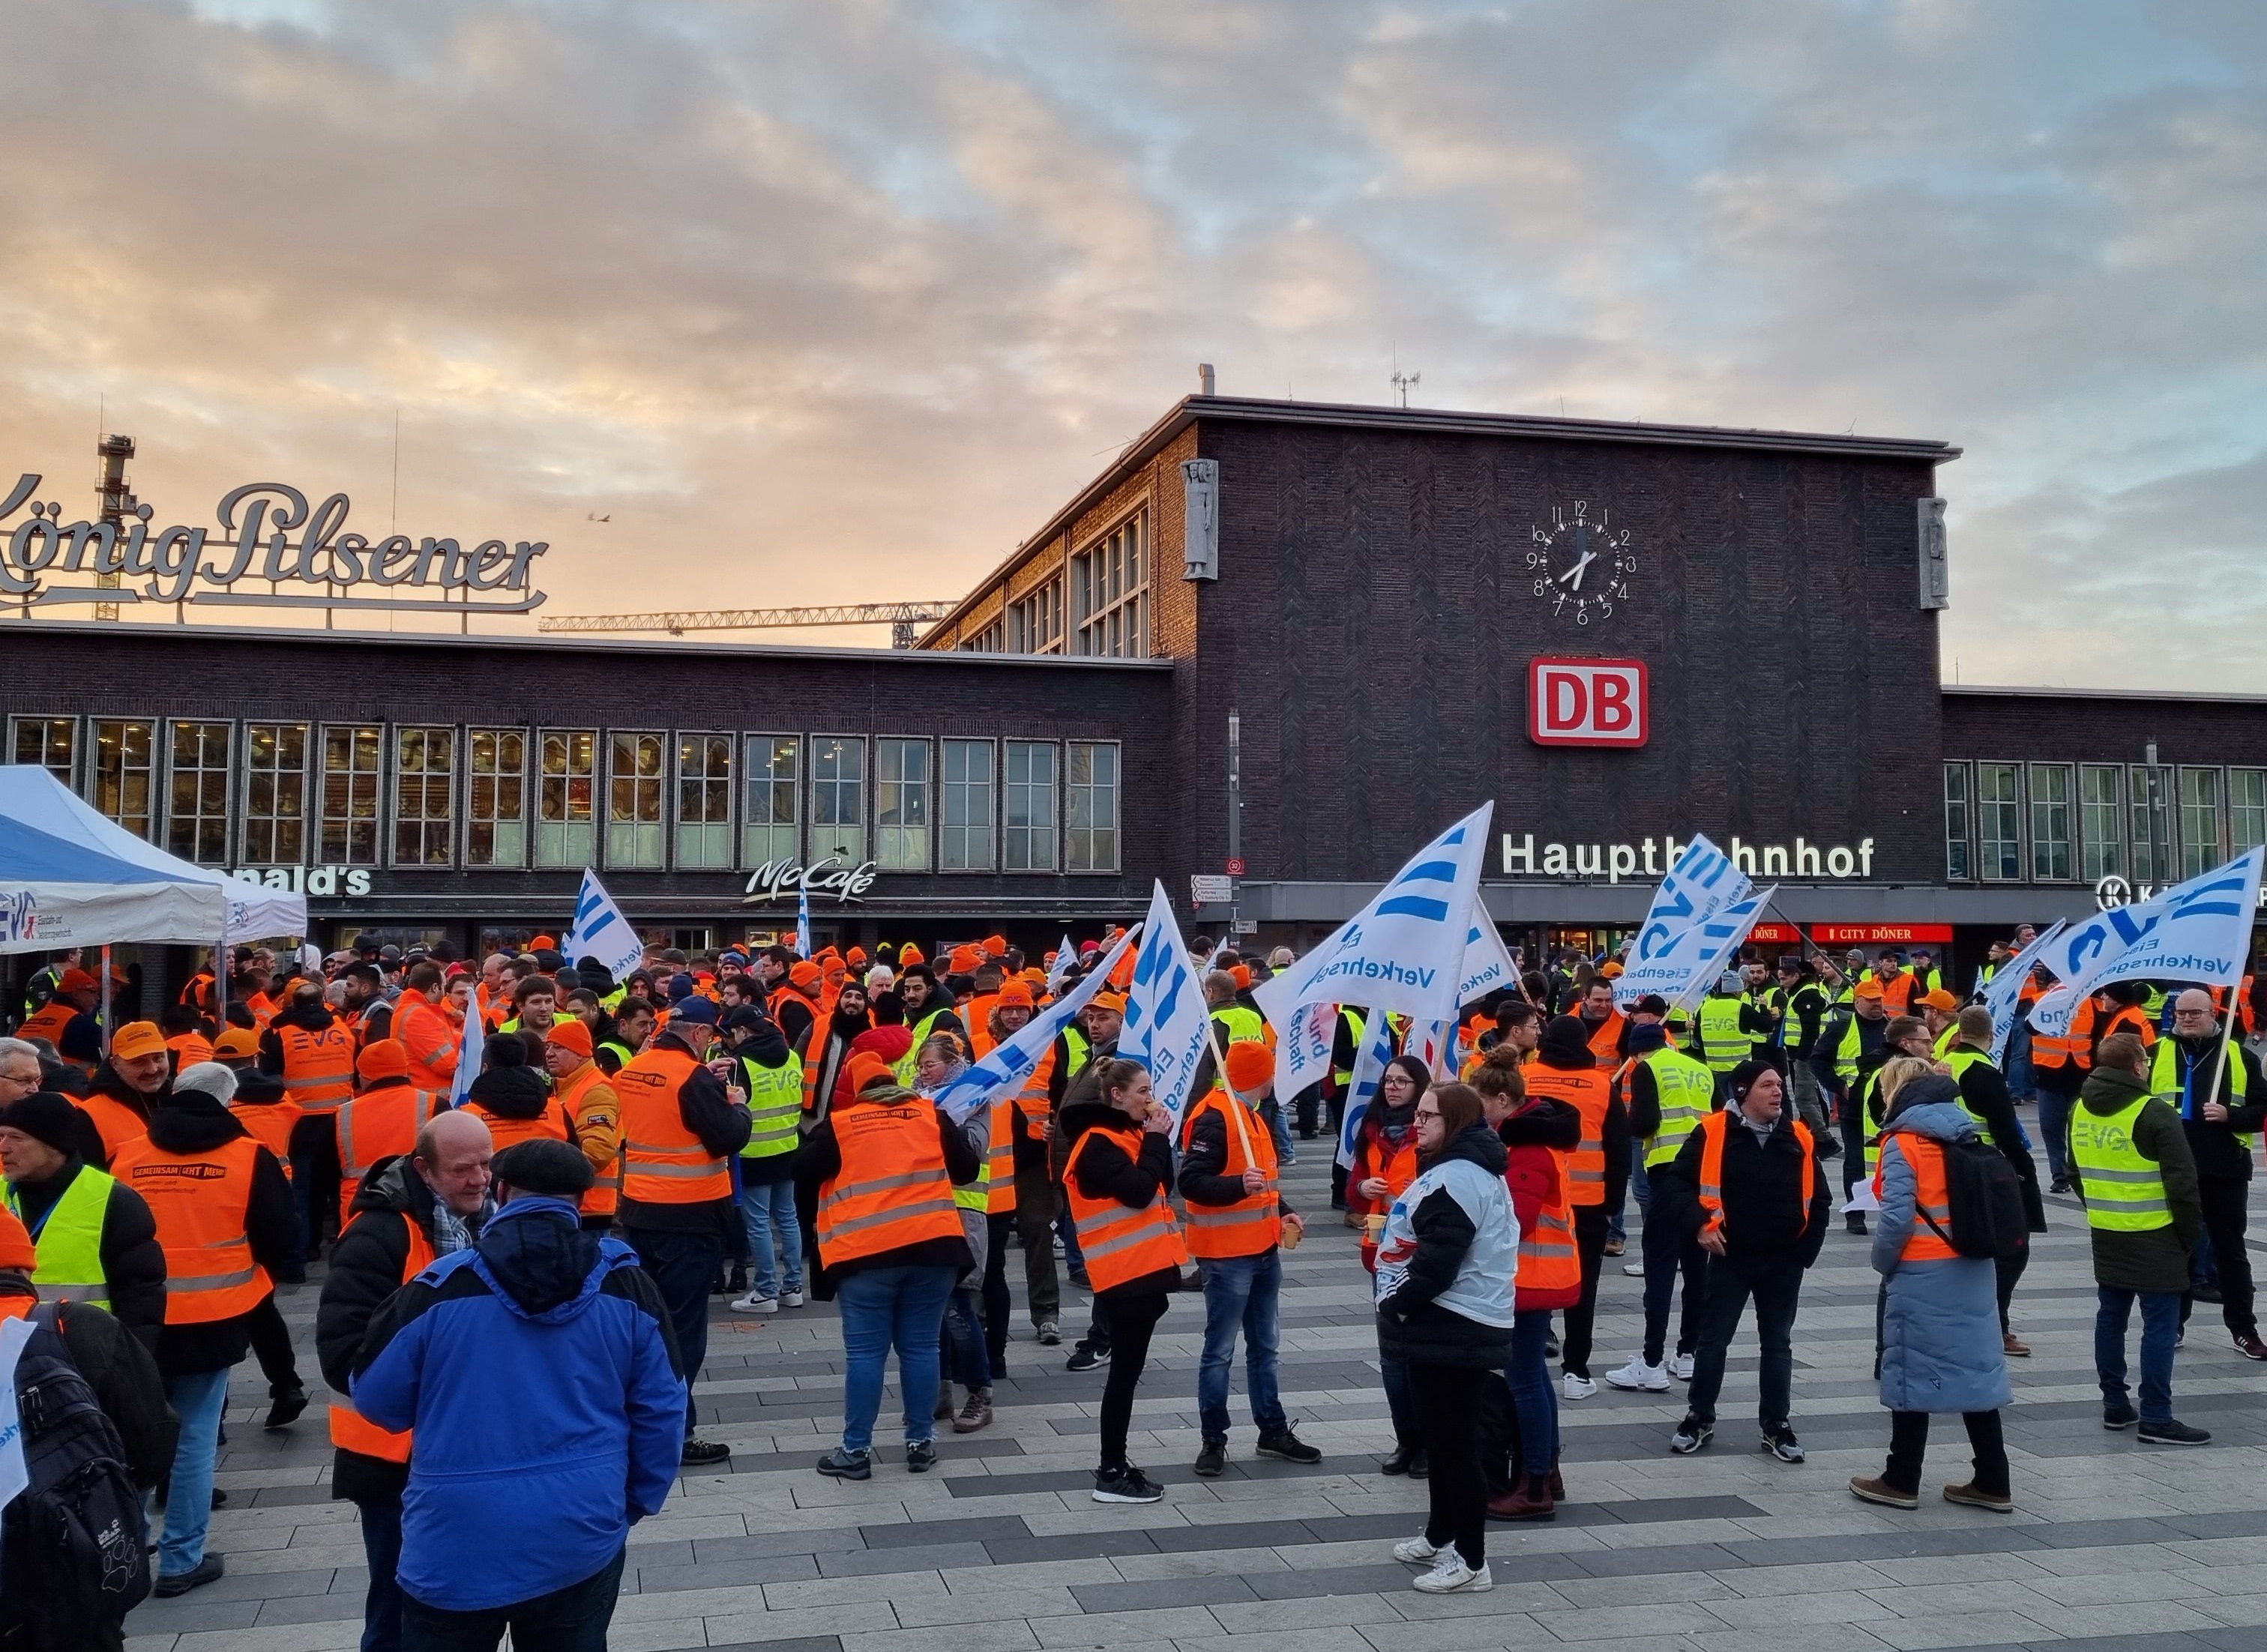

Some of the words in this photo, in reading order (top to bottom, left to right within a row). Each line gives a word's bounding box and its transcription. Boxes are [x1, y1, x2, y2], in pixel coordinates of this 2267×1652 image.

[1552, 507, 1562, 523] 11
[1575, 501, 1587, 518] 12
[202, 483, 549, 591] Pilsener
[1532, 525, 1546, 542] 10
[1621, 529, 1631, 546] 2
[1526, 553, 1538, 570] 9
[1626, 557, 1637, 572] 3
[1534, 579, 1544, 597] 8
[1618, 583, 1629, 600] 4
[1553, 601, 1562, 617] 7
[1577, 609, 1589, 625] 6
[1603, 603, 1612, 619] 5
[1546, 672, 1633, 732] DB
[1502, 833, 1874, 884] Hauptbhnhof
[745, 856, 877, 902] McCafé
[1755, 927, 1778, 940] DÖNER
[1840, 929, 1865, 939] CITY
[1872, 927, 1912, 939] DÖNER
[1703, 1018, 1736, 1031] EVG
[292, 1030, 345, 1050] EVG
[756, 1070, 800, 1091] EVG
[1661, 1067, 1711, 1095] EVG
[2076, 1122, 2129, 1151] EVG
[134, 1166, 178, 1176] GEMEINSAM
[181, 1166, 202, 1175] GEHT
